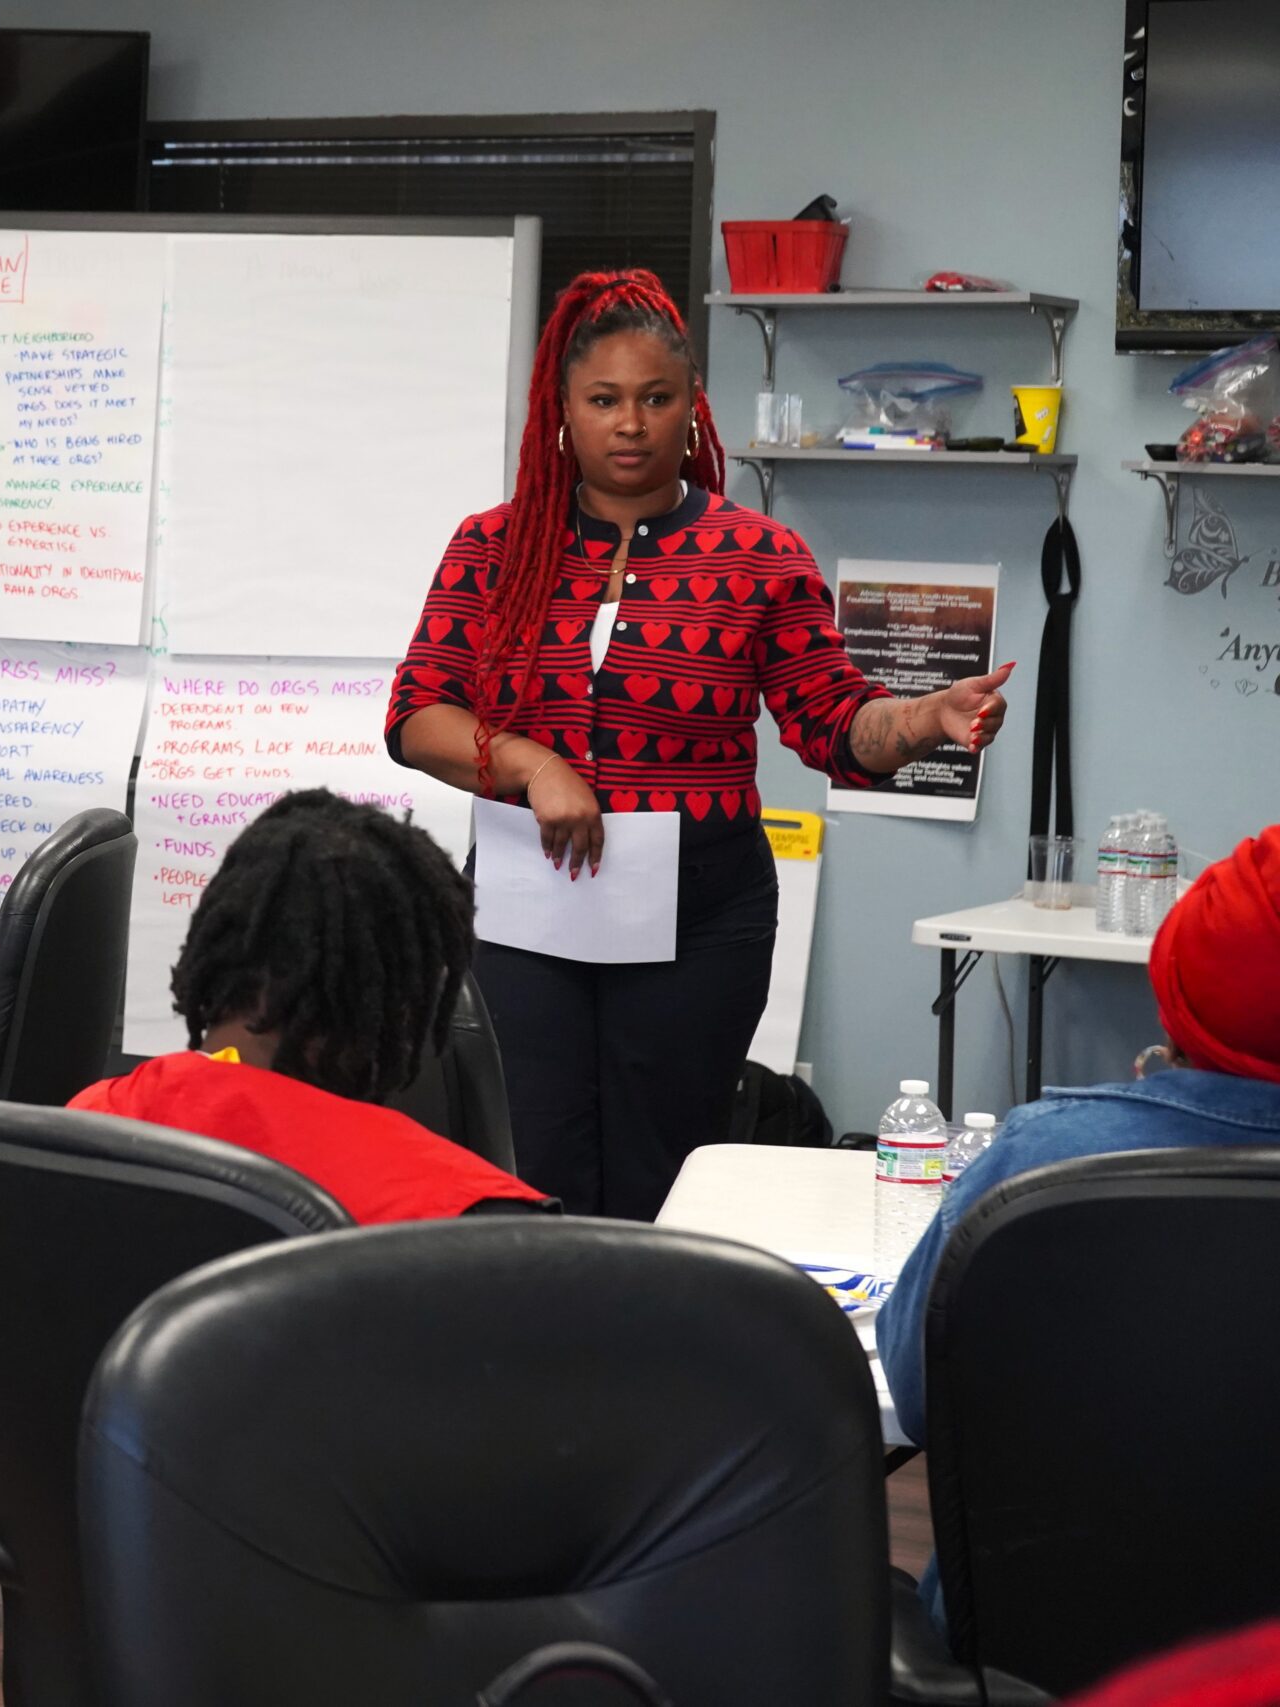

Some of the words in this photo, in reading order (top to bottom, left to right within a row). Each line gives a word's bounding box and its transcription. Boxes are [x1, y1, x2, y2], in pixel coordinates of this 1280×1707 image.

[71, 480, 143, 494] EXPERIENCE
[55, 662, 117, 687] MISS?
[164, 677, 224, 697] WHERE
[238, 679, 259, 695] DO
[270, 679, 320, 696] ORGS
[331, 679, 385, 697] MISS?
[254, 702, 273, 715] ON
[162, 740, 245, 757] PROGRAMS
[255, 739, 294, 755] LACK
[305, 740, 377, 756] MELANIN
[24, 770, 104, 786] AWARENESS
[204, 767, 235, 779] GET
[157, 793, 204, 810] NEED
[34, 822, 52, 833] ON
[0, 848, 16, 860] UP
[164, 838, 216, 858] FUNDS
